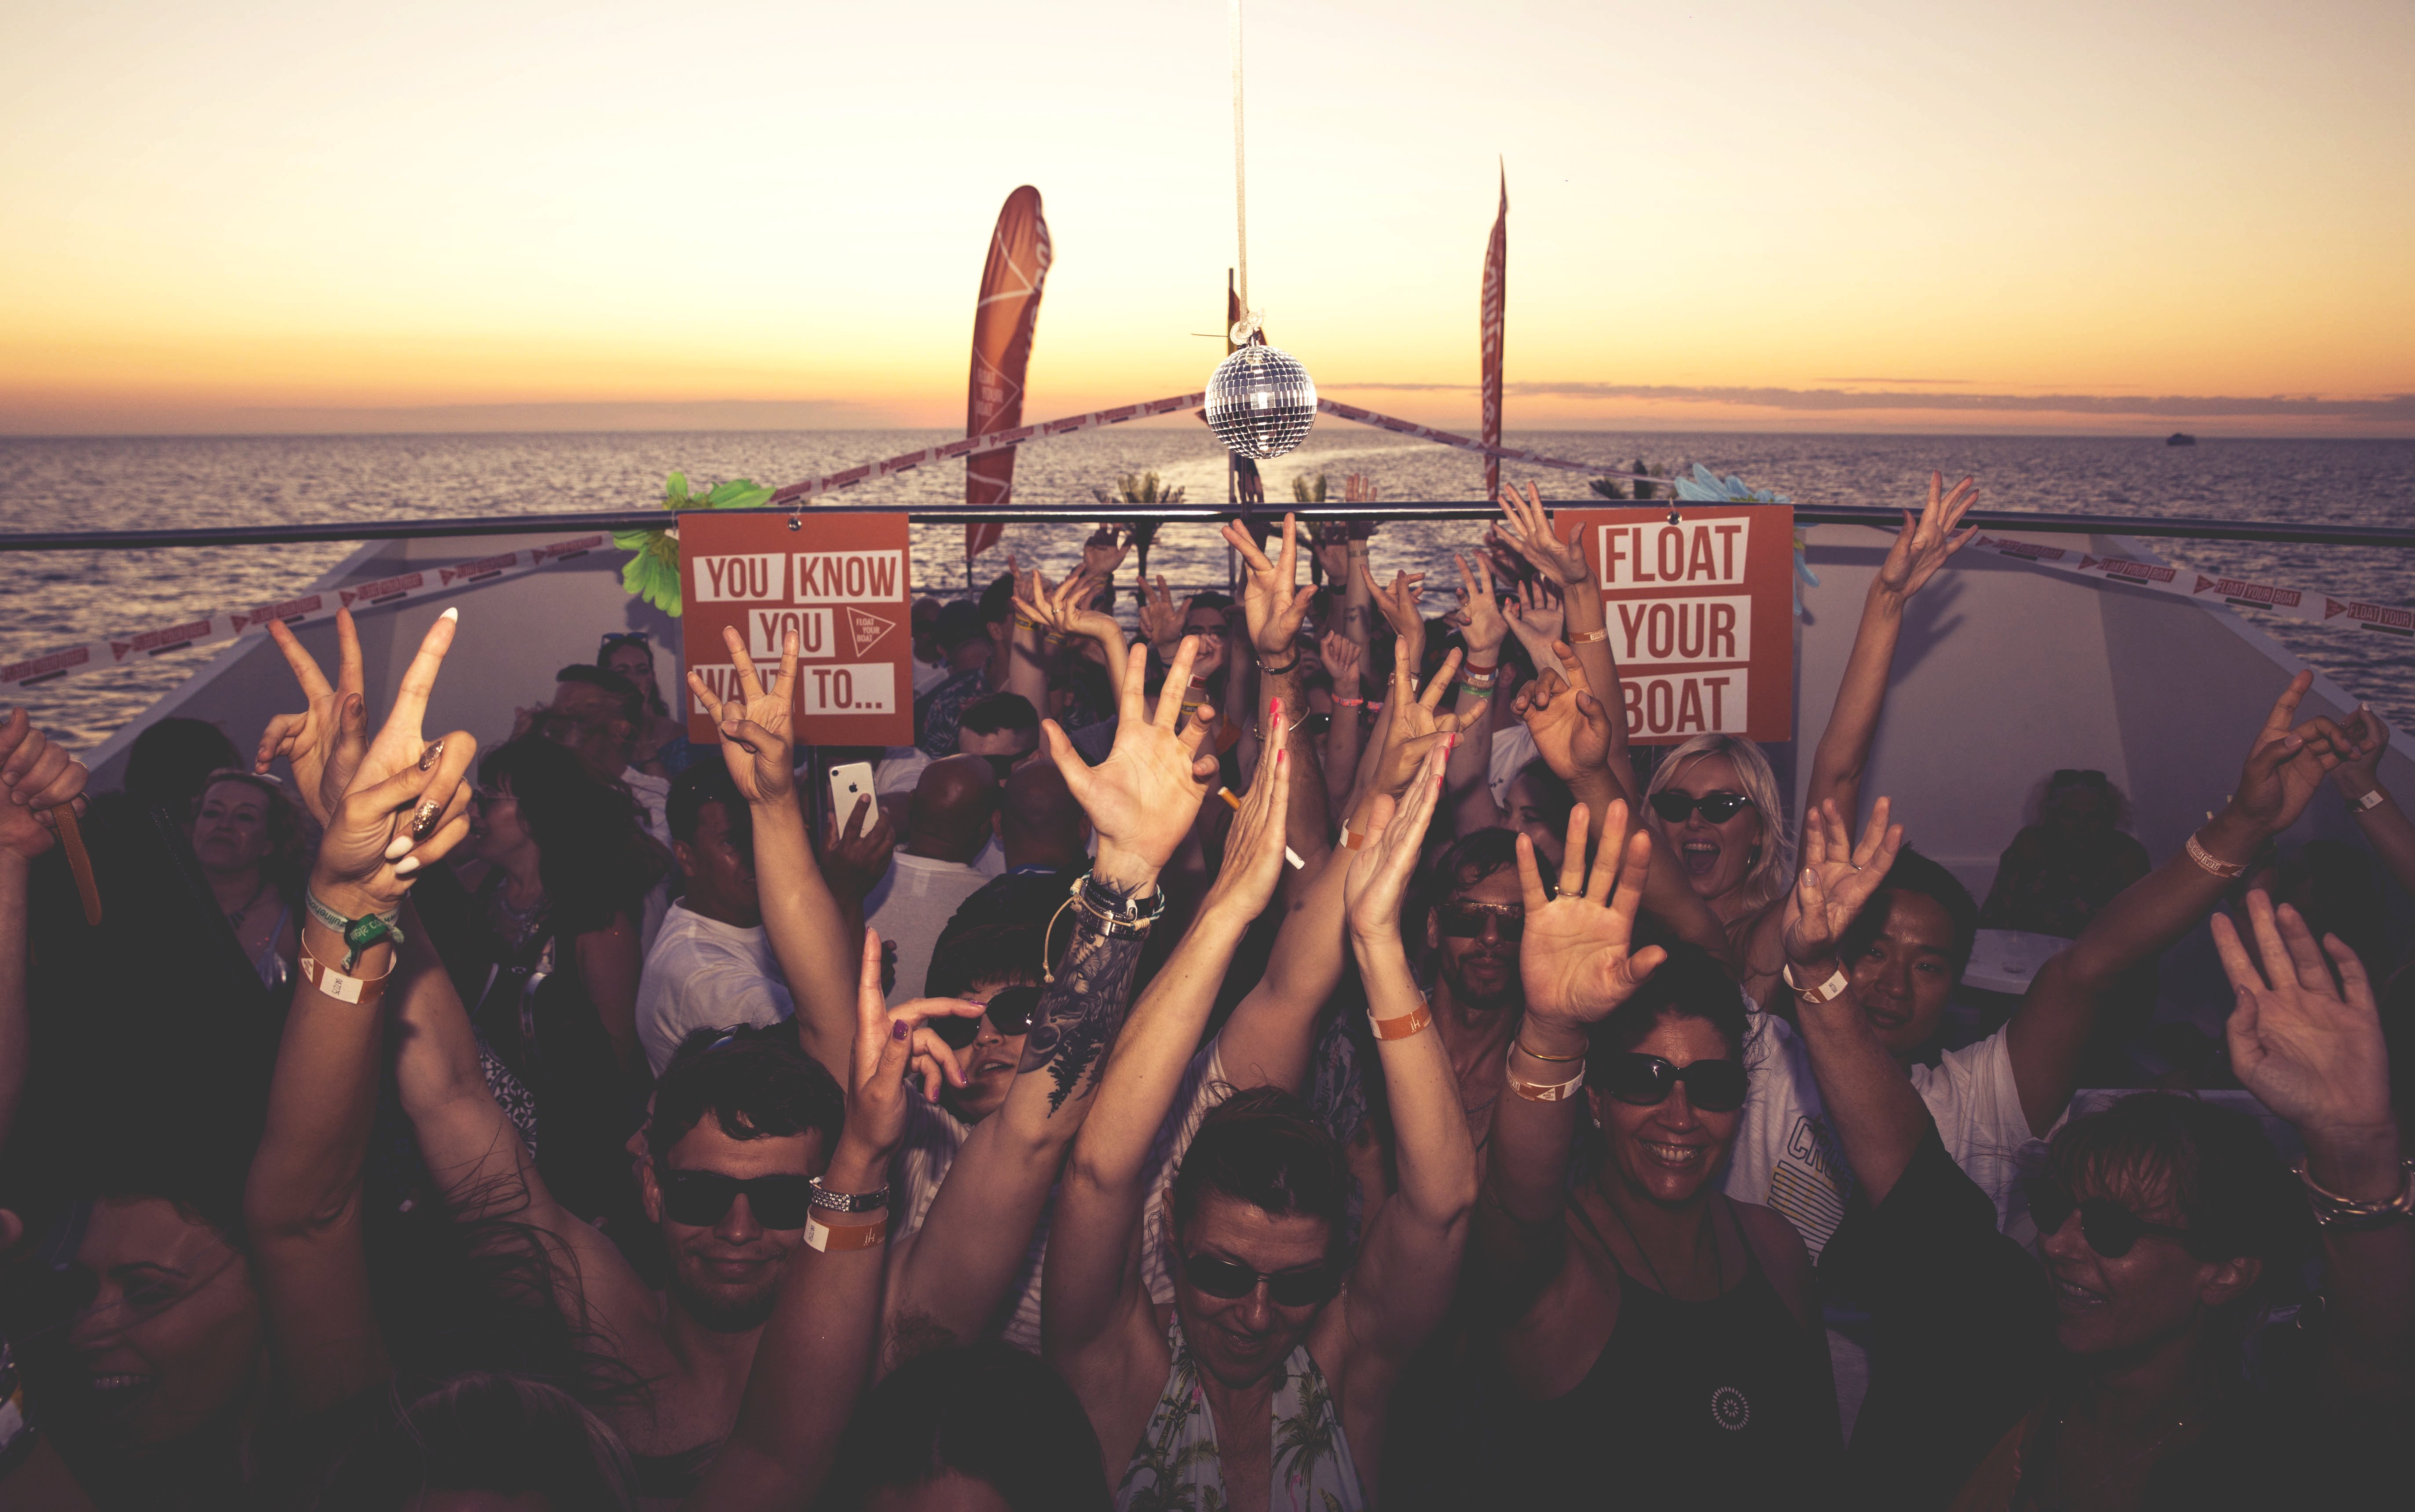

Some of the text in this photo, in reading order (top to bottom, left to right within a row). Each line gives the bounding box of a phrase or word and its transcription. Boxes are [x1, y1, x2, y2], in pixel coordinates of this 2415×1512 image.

[1606, 525, 1741, 582] FLOAT
[2126, 564, 2148, 577] YOUR
[2150, 568, 2174, 581] BOAT
[706, 556, 896, 597] YOU KNOW
[2216, 580, 2299, 606] FLOAT YOUR BOAT
[759, 612, 821, 652] YOU
[1617, 603, 1735, 658] YOUR
[2349, 604, 2410, 626] FLOAT YOUR
[812, 669, 882, 709] TO...
[1621, 677, 1730, 734] BOAT
[2202, 857, 2220, 870] FLOAT
